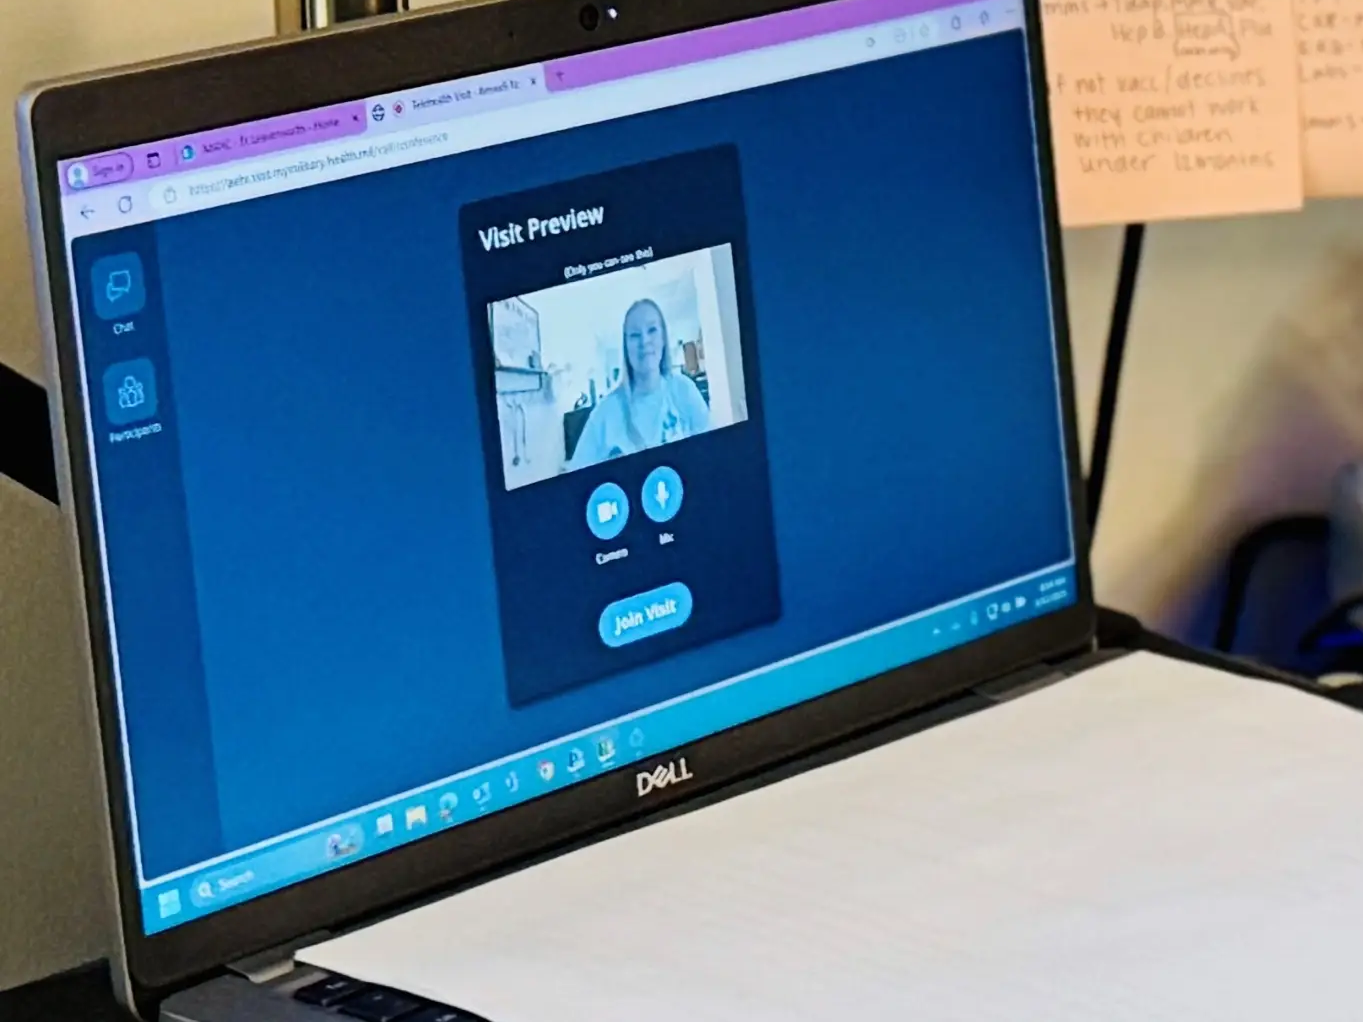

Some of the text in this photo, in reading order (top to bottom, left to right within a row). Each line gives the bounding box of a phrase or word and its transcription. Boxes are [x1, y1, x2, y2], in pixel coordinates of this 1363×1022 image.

[1073, 105, 1122, 128] they
[1132, 99, 1195, 123] cannot
[1073, 132, 1126, 150] with
[1078, 153, 1157, 174] under
[478, 206, 605, 252] Visit Preview
[614, 597, 677, 637] Join Visit
[635, 756, 694, 798] DELL
